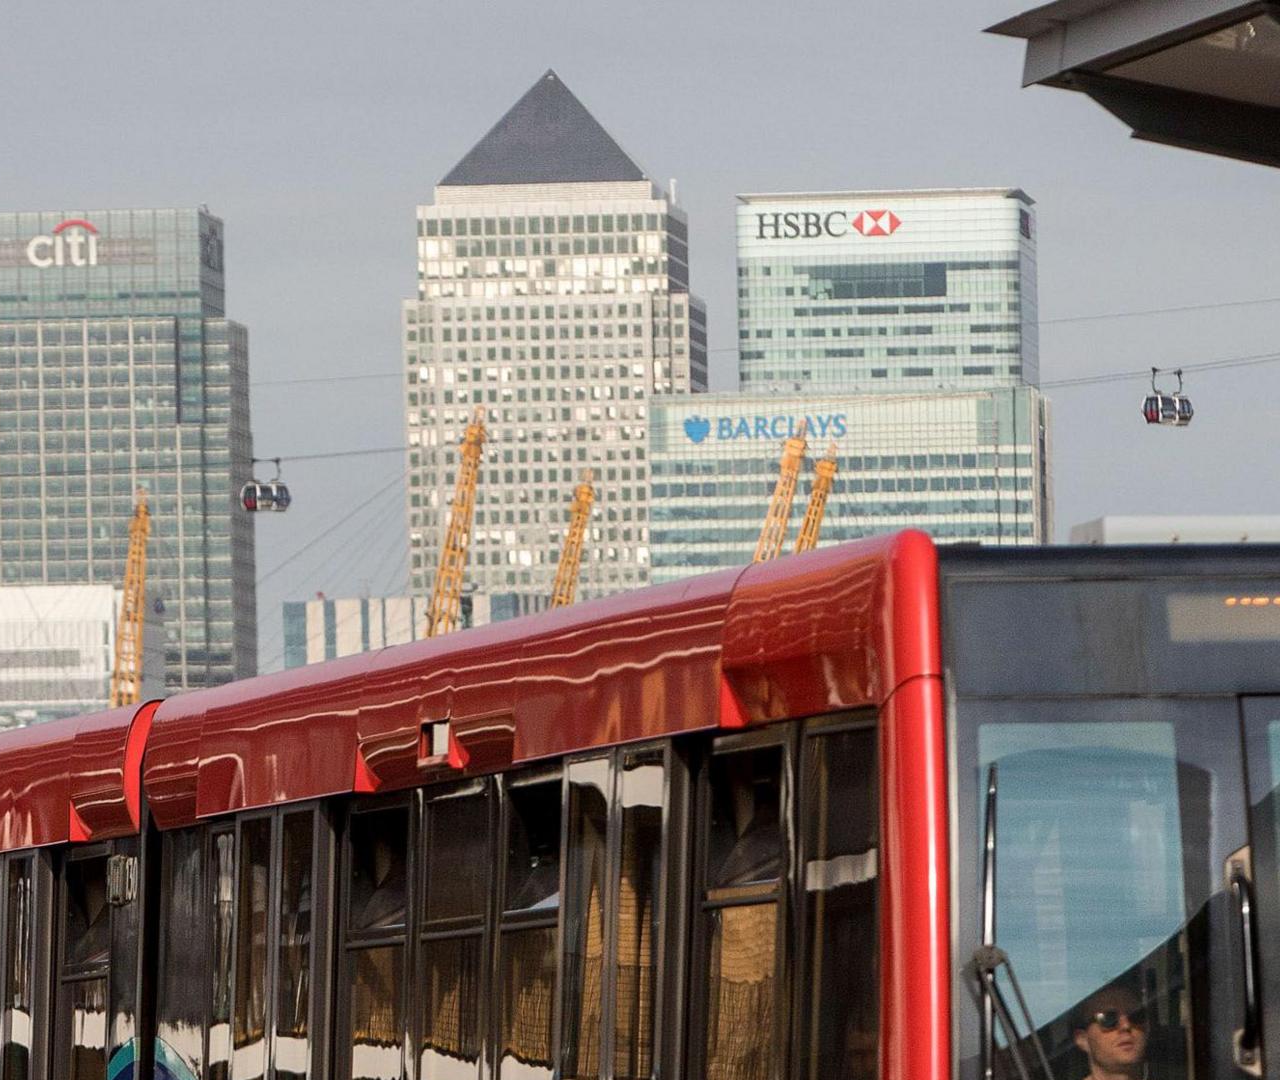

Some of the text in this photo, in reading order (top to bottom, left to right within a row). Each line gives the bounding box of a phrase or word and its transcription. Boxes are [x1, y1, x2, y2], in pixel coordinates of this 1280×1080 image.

[755, 211, 847, 239] HSBC
[26, 219, 99, 267] citi
[717, 413, 848, 440] BARCLAYS
